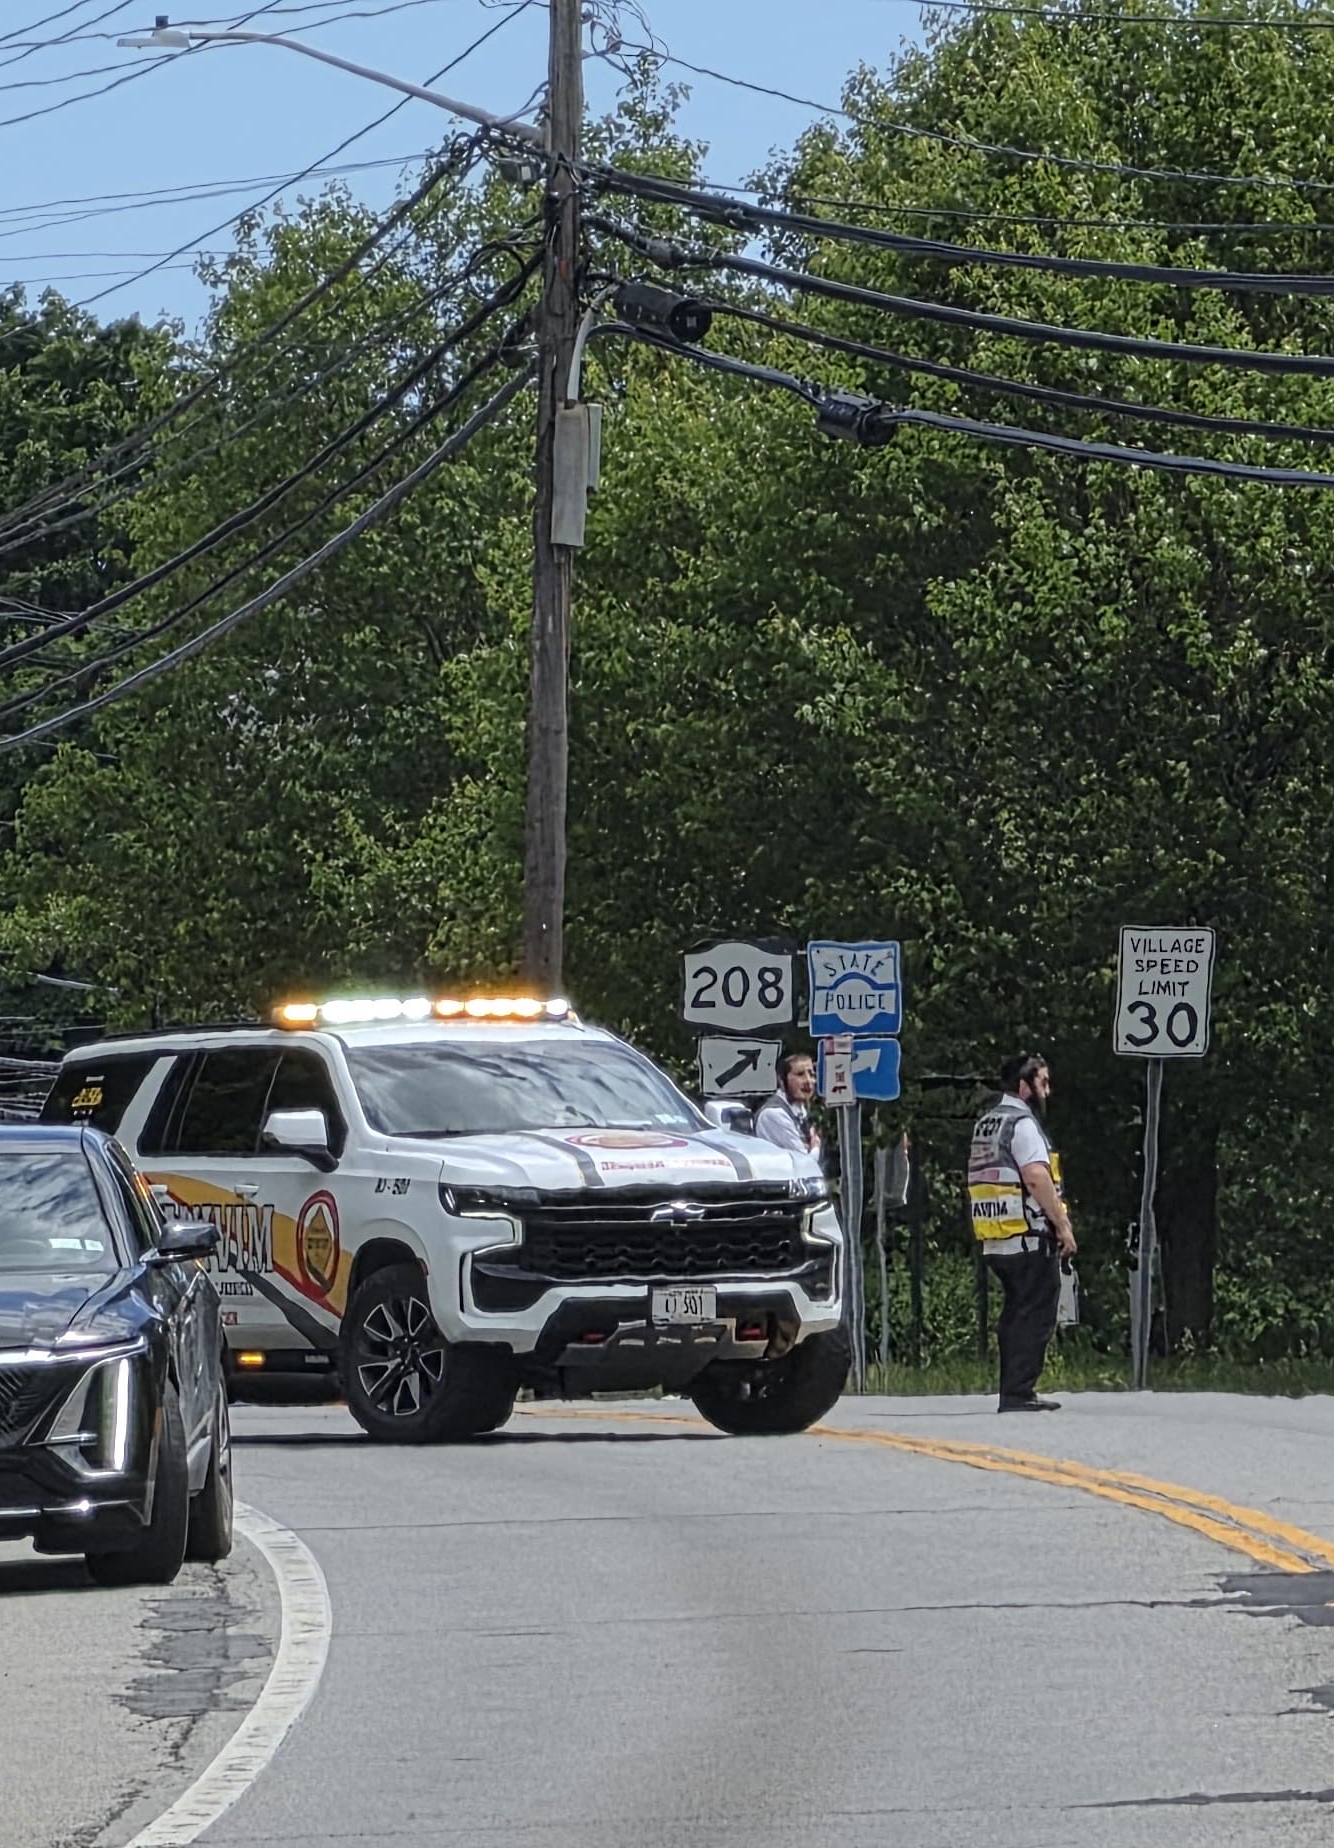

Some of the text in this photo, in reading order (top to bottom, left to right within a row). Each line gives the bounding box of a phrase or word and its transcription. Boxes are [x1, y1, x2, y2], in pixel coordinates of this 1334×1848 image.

[1130, 937, 1205, 955] VILLAGE
[823, 952, 885, 977] STATE
[1134, 958, 1199, 975] SPEED
[690, 965, 785, 1009] 208
[1138, 980, 1190, 997] LIMIT
[824, 990, 886, 1012] POLICE
[1125, 1000, 1199, 1048] 30
